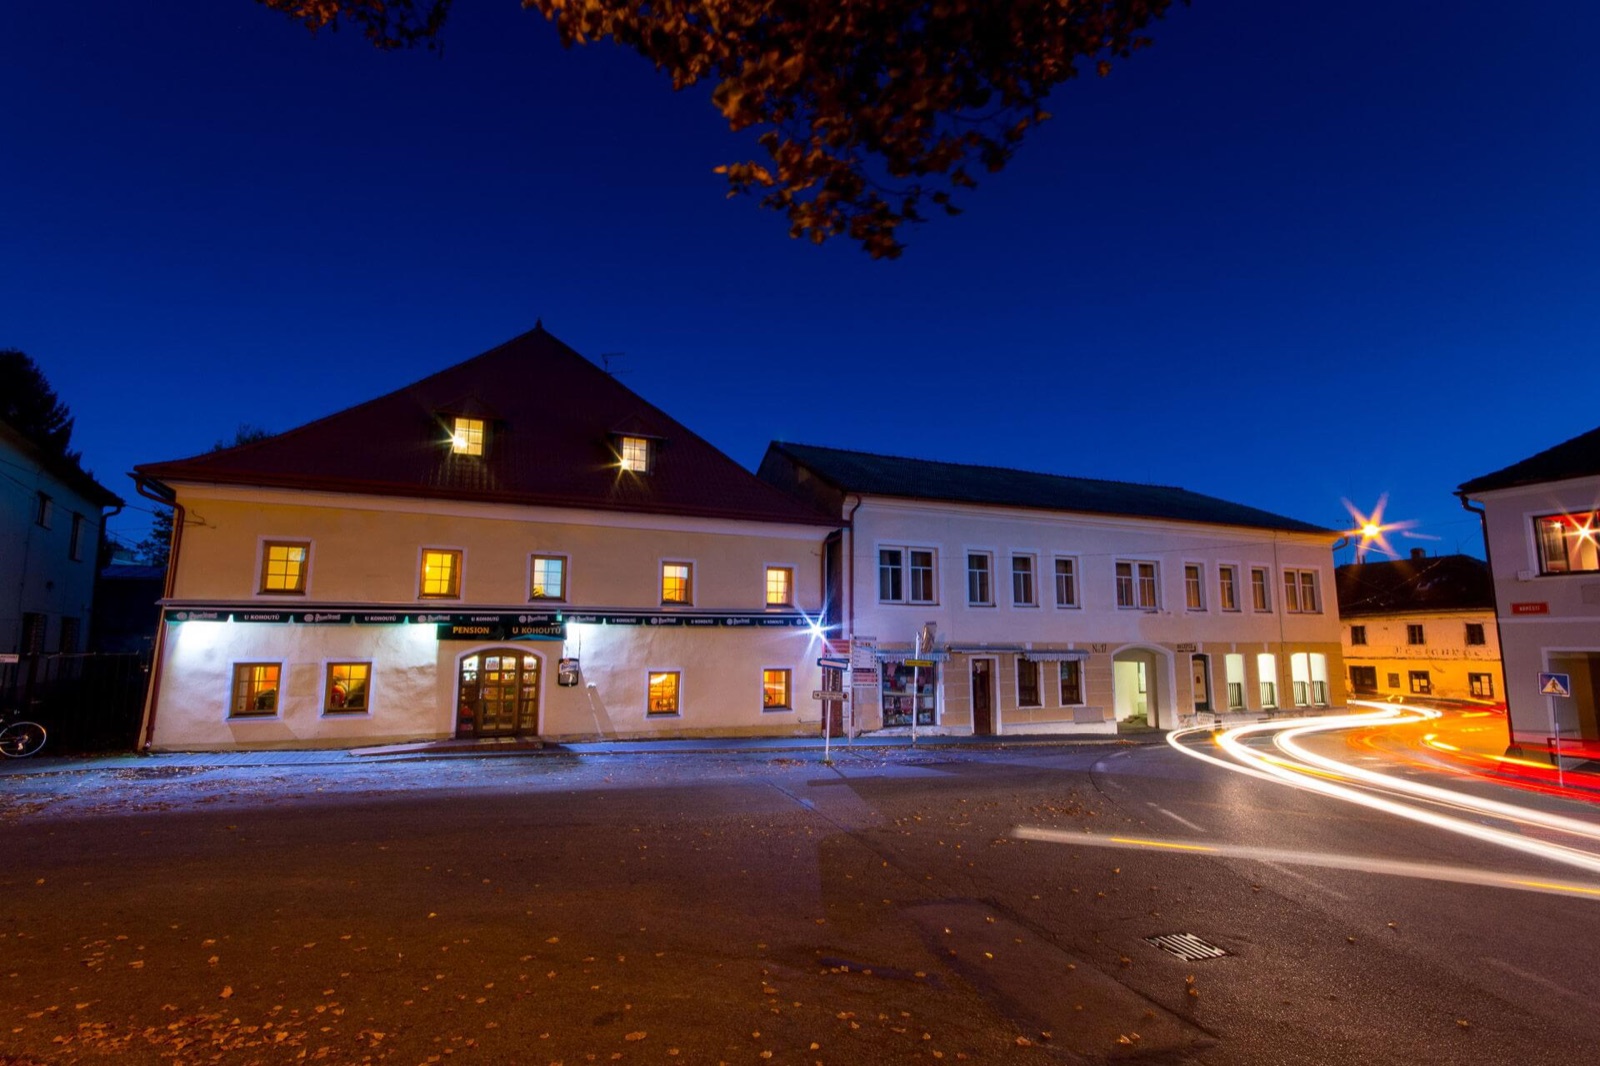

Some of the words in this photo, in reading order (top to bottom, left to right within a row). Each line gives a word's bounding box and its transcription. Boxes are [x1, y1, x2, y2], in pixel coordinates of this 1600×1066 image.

[453, 626, 490, 635] PENSION
[512, 626, 519, 635] U
[521, 625, 562, 635] KOHOUTŮ
